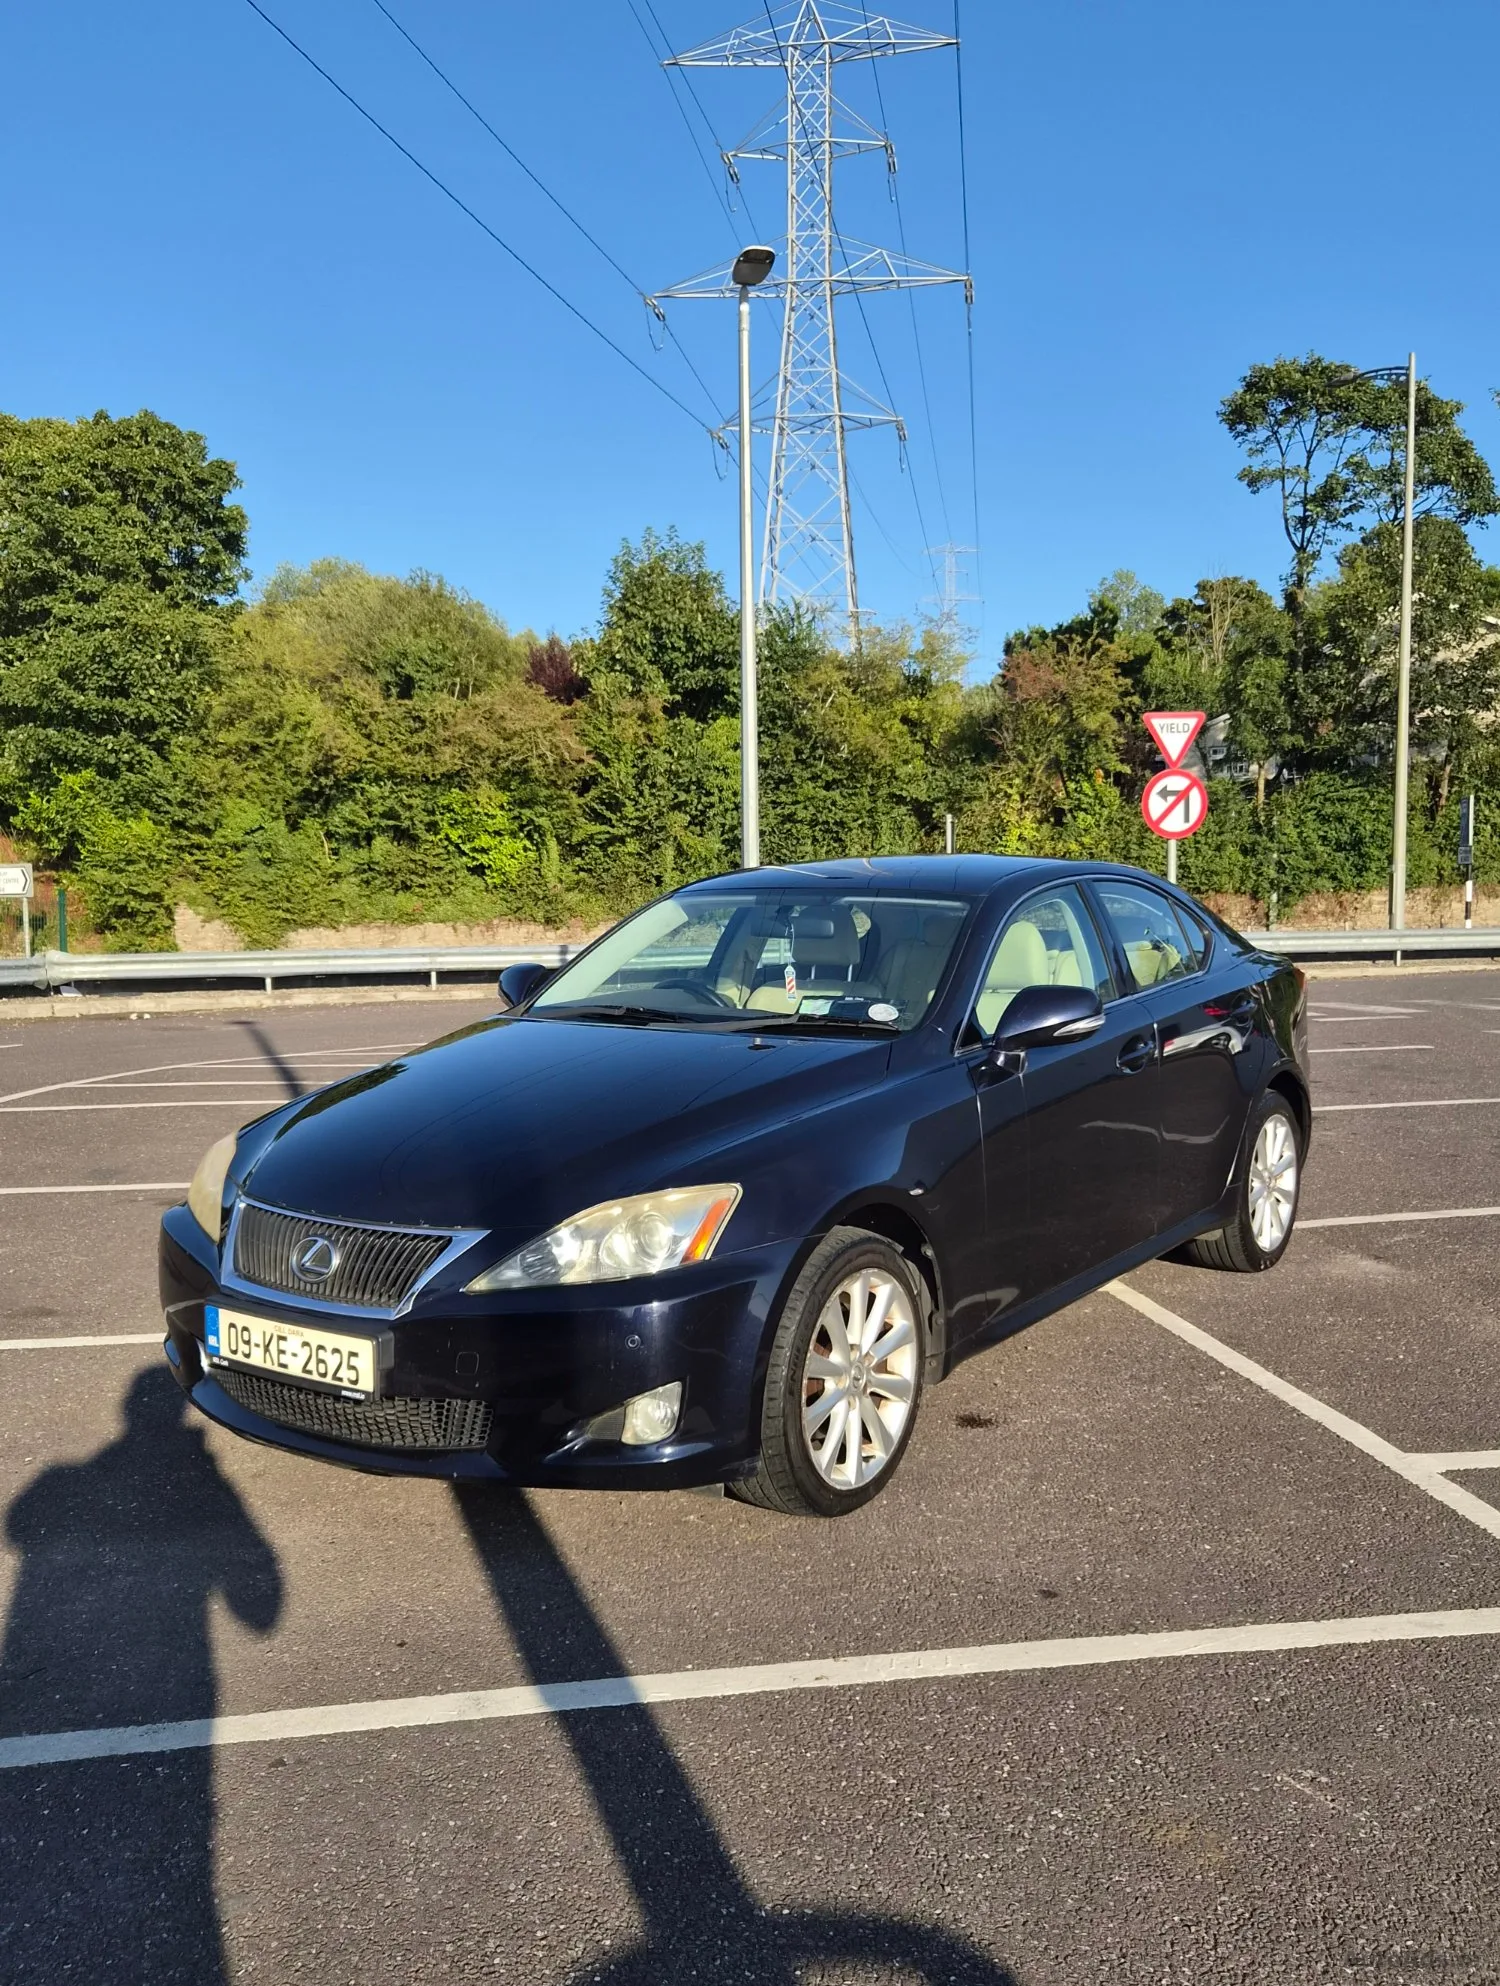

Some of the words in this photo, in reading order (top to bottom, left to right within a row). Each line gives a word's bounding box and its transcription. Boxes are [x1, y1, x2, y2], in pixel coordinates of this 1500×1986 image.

[1159, 723, 1190, 733] YIELD
[288, 1328, 304, 1337] DARA
[227, 1322, 360, 1386] 09-KE-2625
